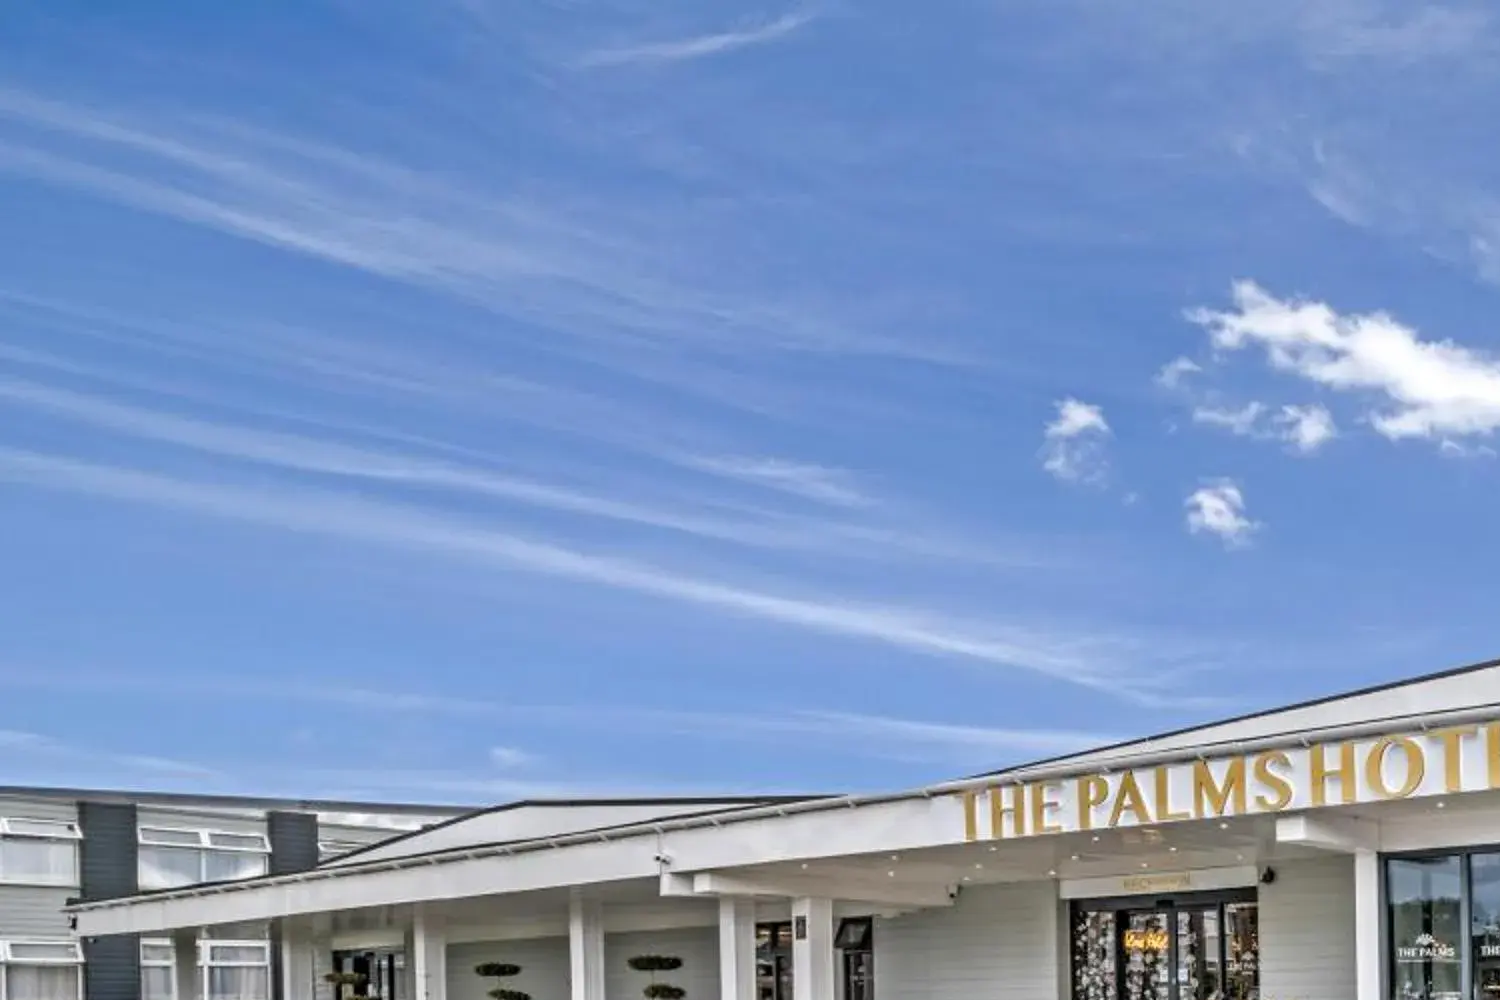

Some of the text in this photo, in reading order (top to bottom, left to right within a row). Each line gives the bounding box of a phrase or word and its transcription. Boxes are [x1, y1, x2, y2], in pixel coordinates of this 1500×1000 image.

[956, 779, 1062, 842] THE
[1077, 750, 1292, 830] PALMS
[1398, 946, 1456, 957] THE PALMS
